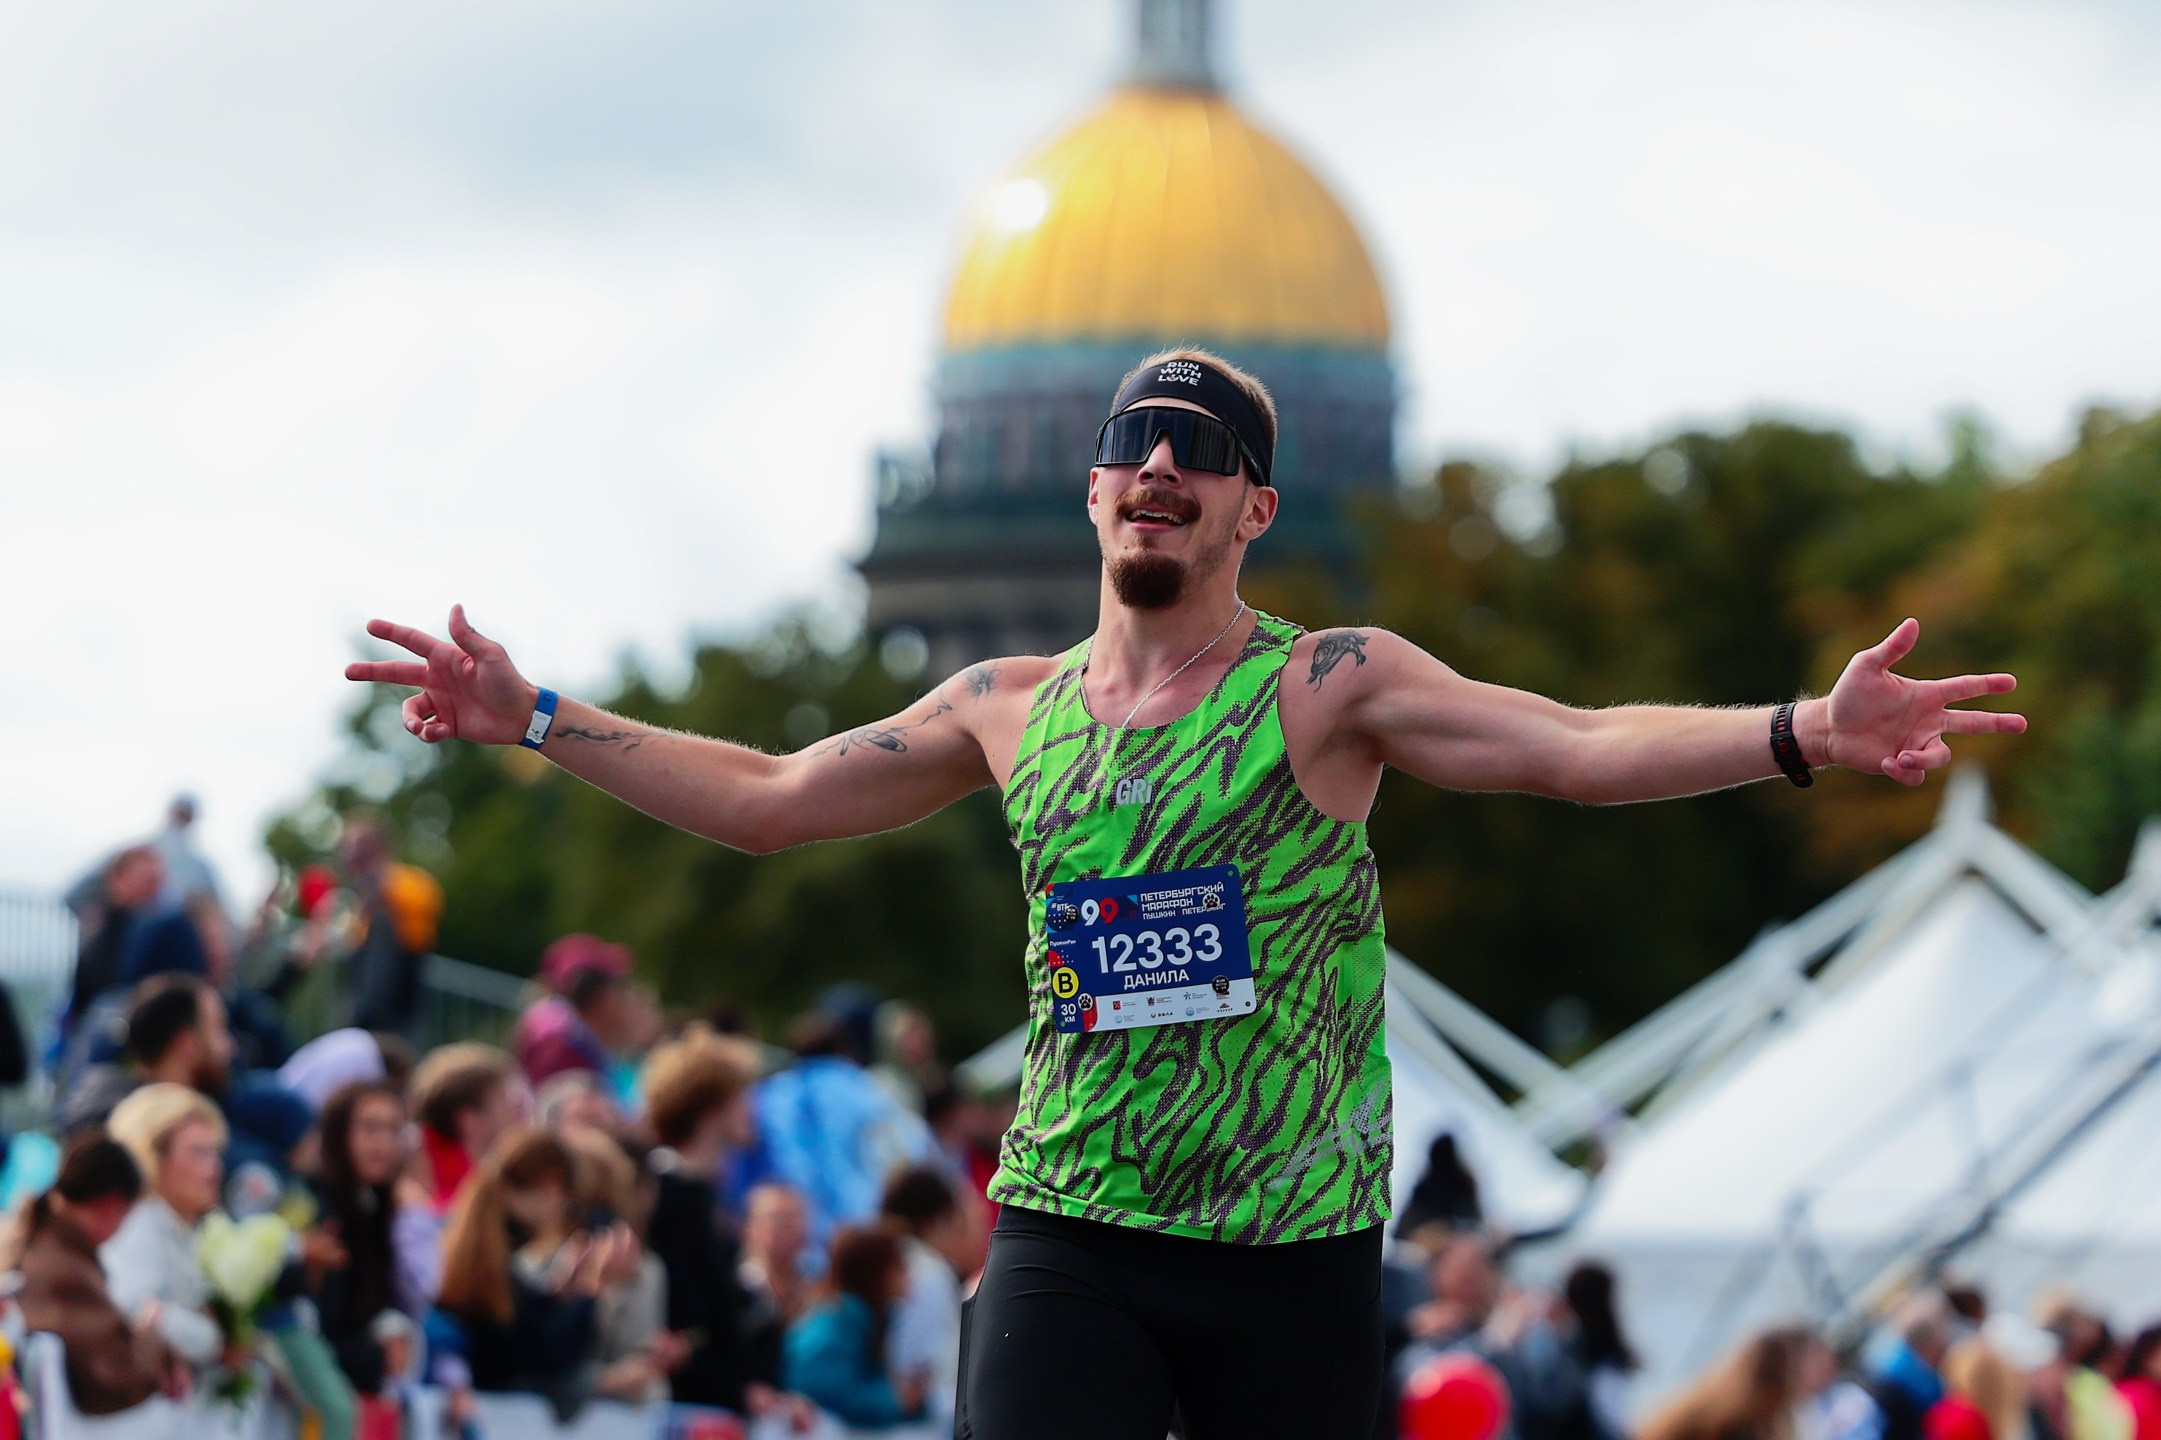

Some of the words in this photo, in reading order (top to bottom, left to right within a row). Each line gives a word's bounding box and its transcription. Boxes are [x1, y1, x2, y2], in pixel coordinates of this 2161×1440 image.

[1168, 362, 1199, 371] RUN
[1161, 368, 1202, 379] WITH
[1159, 375, 1199, 386] LOVE
[1141, 882, 1224, 902] ПЕТЕРБУРГСКИЙ
[1142, 899, 1194, 912] МАРАФОН
[1082, 898, 1119, 926] 99
[1143, 910, 1176, 920] ПУШКИН
[1092, 924, 1223, 974] 12333
[1124, 970, 1190, 990] ДАНИЛА
[1061, 1004, 1077, 1016] 30
[1065, 1016, 1076, 1024] КМ
